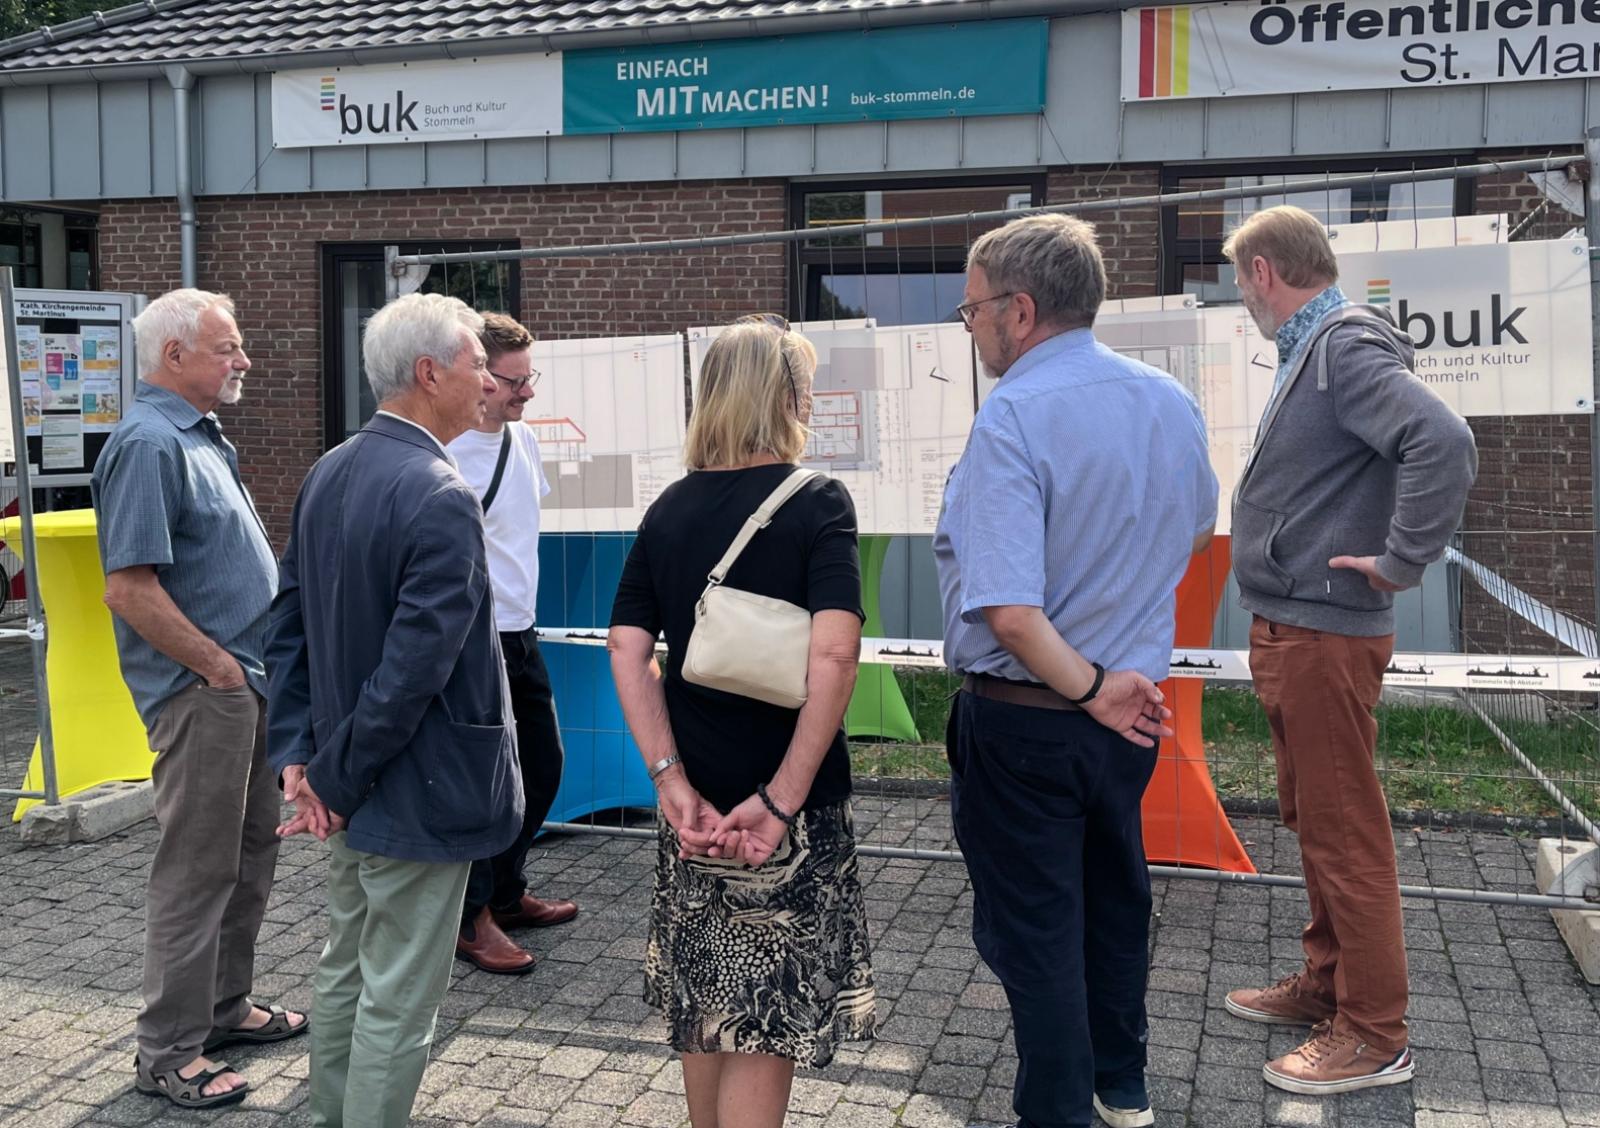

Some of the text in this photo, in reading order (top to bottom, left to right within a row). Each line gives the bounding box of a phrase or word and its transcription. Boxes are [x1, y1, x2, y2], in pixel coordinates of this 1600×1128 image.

[1250, 0, 1600, 45] Öffentliche
[616, 56, 709, 81] EINFACH
[1400, 42, 1471, 83] St.
[636, 84, 830, 117] MITMACHEN!
[850, 86, 976, 106] buk-stommeln.de
[339, 90, 419, 135] buk
[424, 101, 507, 115] Buch und Kultur
[424, 116, 475, 128] Stommeln
[32, 310, 66, 318] Martinus
[42, 303, 106, 312] Kirchengemeinde
[1399, 293, 1529, 350] buk
[1414, 352, 1531, 368] ch und Kultur
[1415, 370, 1480, 383] ommeln
